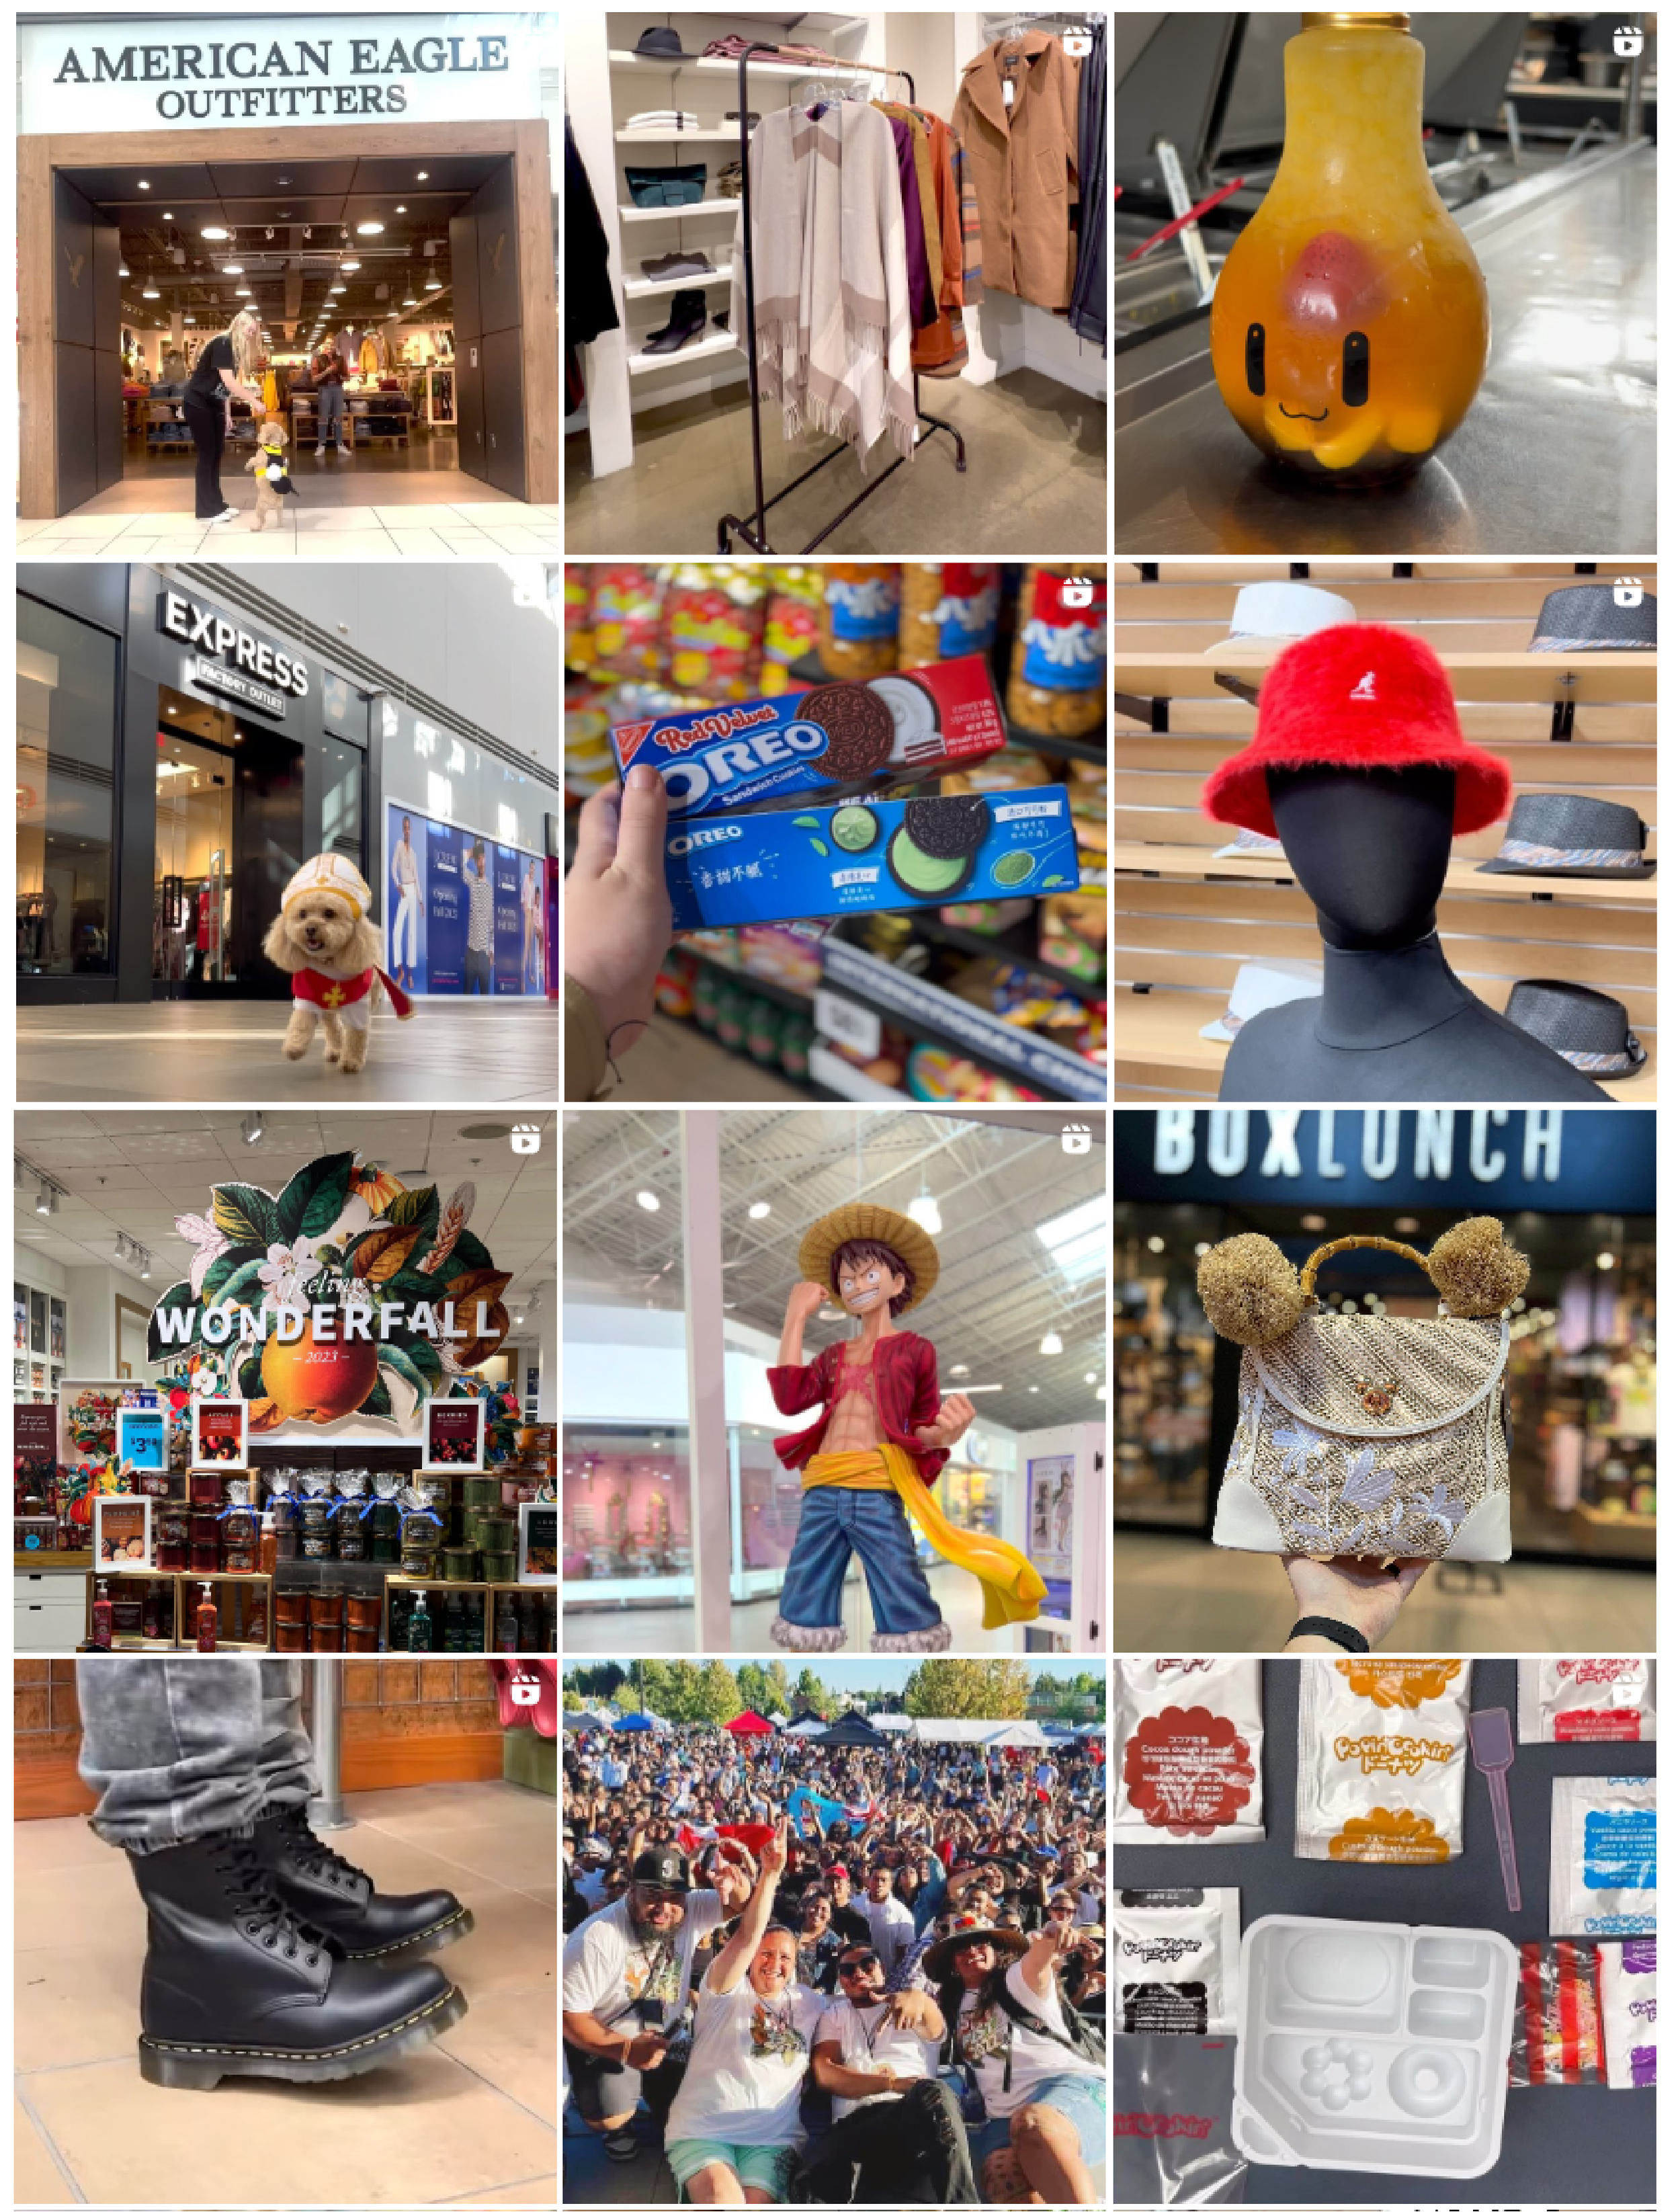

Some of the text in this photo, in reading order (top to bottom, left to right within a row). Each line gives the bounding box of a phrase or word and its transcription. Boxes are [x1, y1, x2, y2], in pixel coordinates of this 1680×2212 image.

[53, 35, 509, 83] AMERICAN EAGLE
[156, 84, 407, 119] OUTFITTERS
[166, 589, 308, 696] EXPRESS
[201, 663, 283, 710] FACTORY OUTLET
[655, 704, 779, 753] Red Velvet
[662, 724, 823, 811] OREO
[667, 825, 742, 854] OREO
[1154, 1110, 1562, 1182] BOXLUNCH
[156, 1301, 501, 1344] WONDERFALL
[1141, 1744, 1169, 1753] Cocoa
[1171, 1744, 1200, 1756] dough
